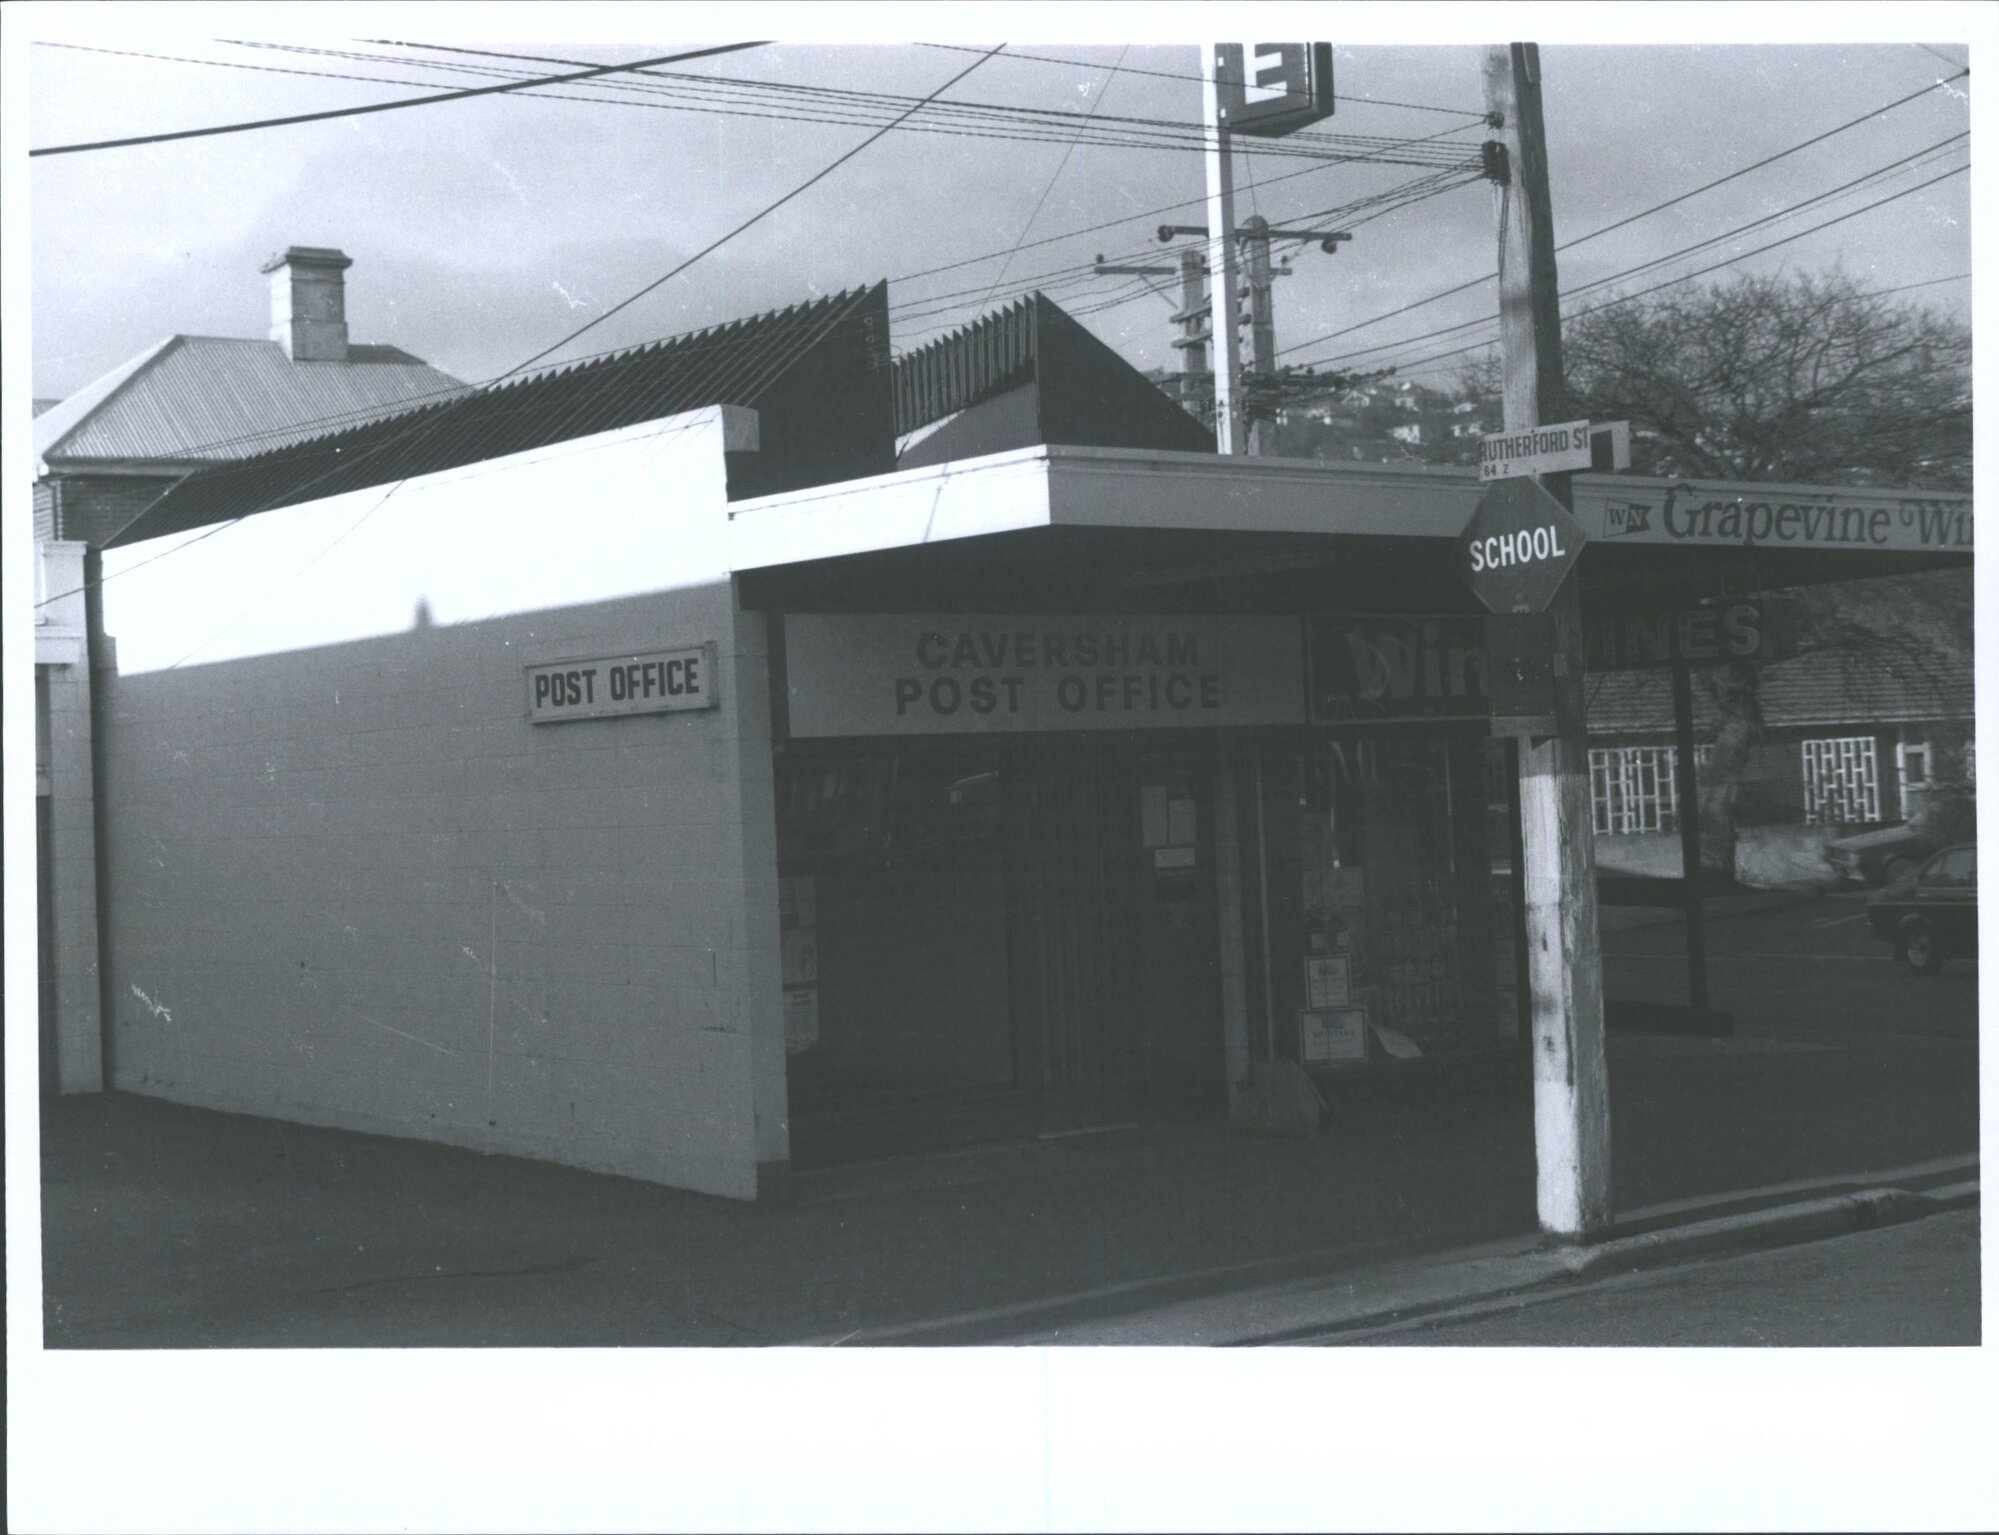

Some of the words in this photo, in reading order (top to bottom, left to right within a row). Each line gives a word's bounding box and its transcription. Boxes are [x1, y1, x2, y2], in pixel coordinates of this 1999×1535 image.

[1479, 430, 1569, 462] RUTHERFORD
[1573, 427, 1588, 450] ST
[1663, 483, 1891, 547] Grapevine
[1469, 525, 1565, 572] SCHOOL
[916, 631, 1201, 669] CAVERSHAM
[1583, 604, 1761, 665] INES
[535, 669, 597, 708] POST
[609, 658, 700, 701] OFFICE
[895, 676, 1025, 716] POST
[1056, 674, 1221, 713] OFFICE
